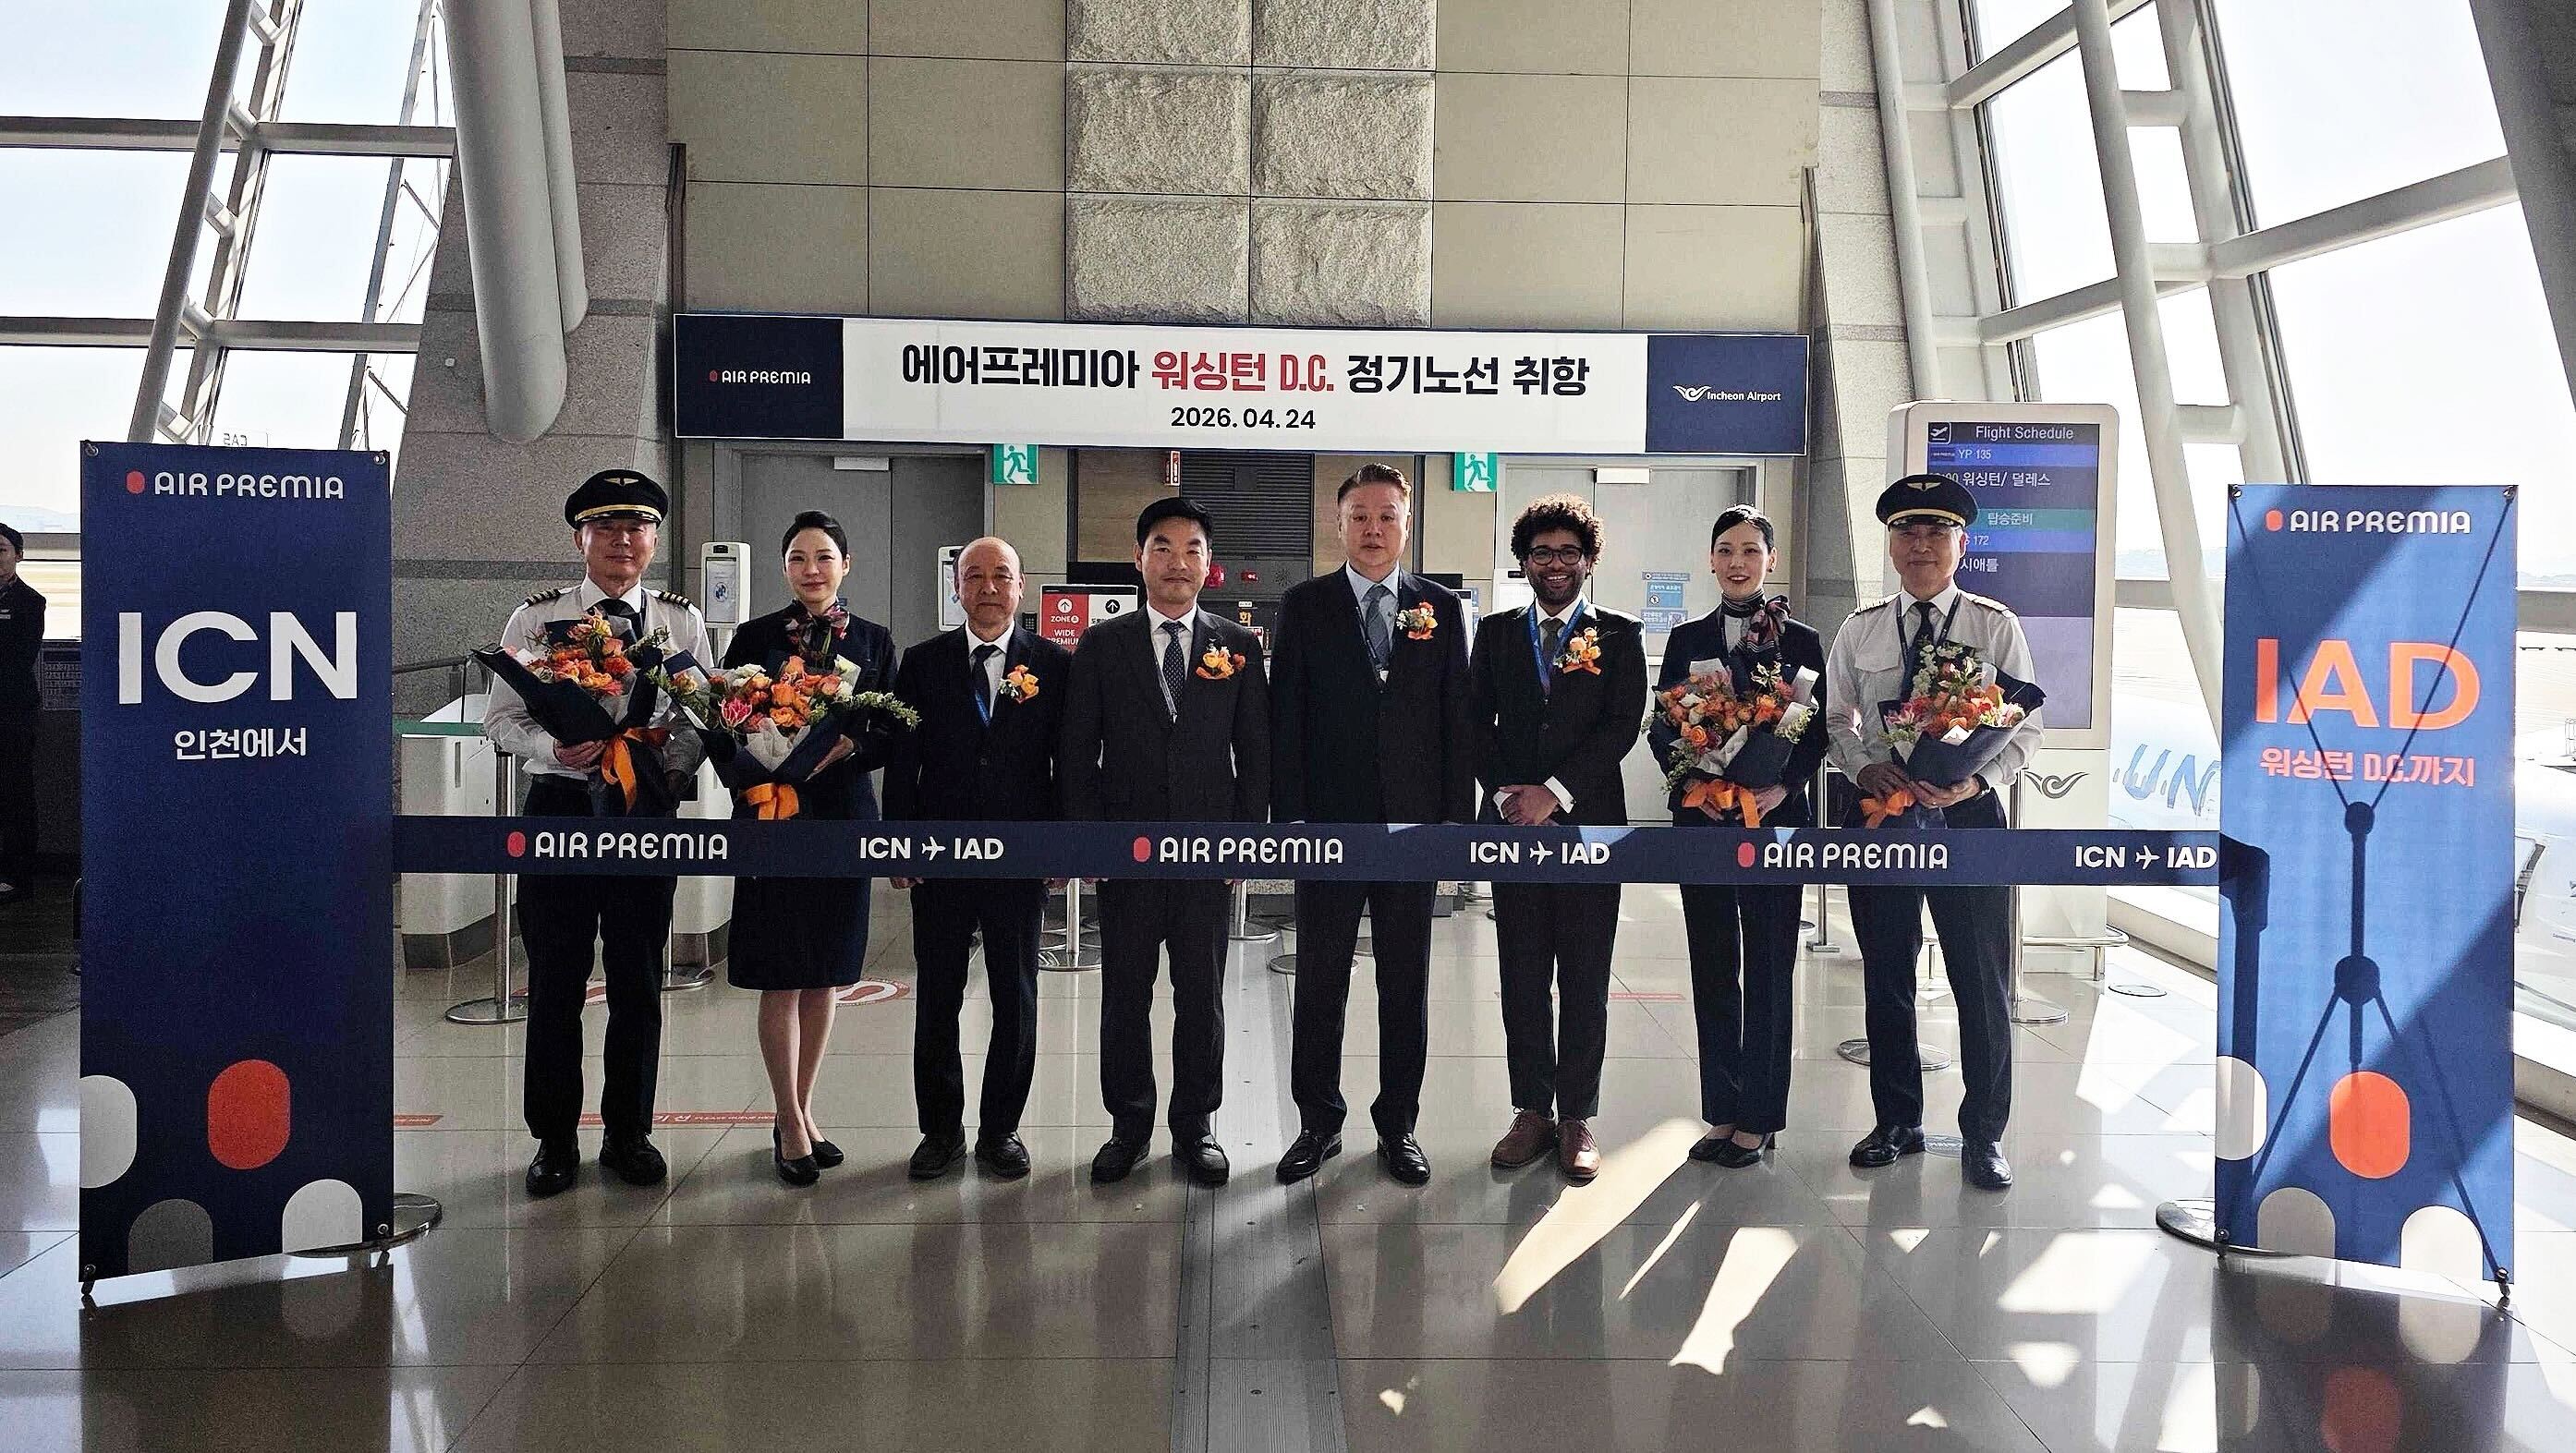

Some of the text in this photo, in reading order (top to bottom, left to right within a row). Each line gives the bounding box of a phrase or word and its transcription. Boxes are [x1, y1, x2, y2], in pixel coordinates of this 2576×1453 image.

[722, 369, 811, 384] AIR PREMIA
[902, 344, 1590, 396] 에어프레미아 워싱턴 D.C. 정기노선 취항
[1707, 391, 1781, 403] Incheon Airport
[1975, 426, 2074, 442] Flight Schedule
[1958, 449, 1974, 460] YP
[1975, 449, 1992, 460] 135
[154, 471, 344, 500] AIR PREMIA
[1962, 472, 2008, 488] 워싱턴/
[2011, 472, 2051, 487] 덜레스
[1987, 512, 2033, 526] 탑승준비
[2290, 510, 2471, 534] AIR PREMIA
[1973, 535, 1989, 546] 172
[1960, 558, 1999, 573] 시애틀
[1053, 629, 1075, 637] WIDE
[118, 611, 358, 705] ICN
[2255, 638, 2481, 730] IAD
[174, 727, 307, 760] 인천에서
[2260, 746, 2475, 787] 워싱턴 D.C.까지
[535, 831, 728, 860] AIR PREMIA
[859, 837, 1004, 860] ICN IAD
[1160, 836, 1343, 864] AIR PREMIA
[1470, 842, 1610, 865] ICN IAD
[1764, 842, 1948, 869] AIR PREMIA
[2075, 845, 2218, 868] ICN IAD
